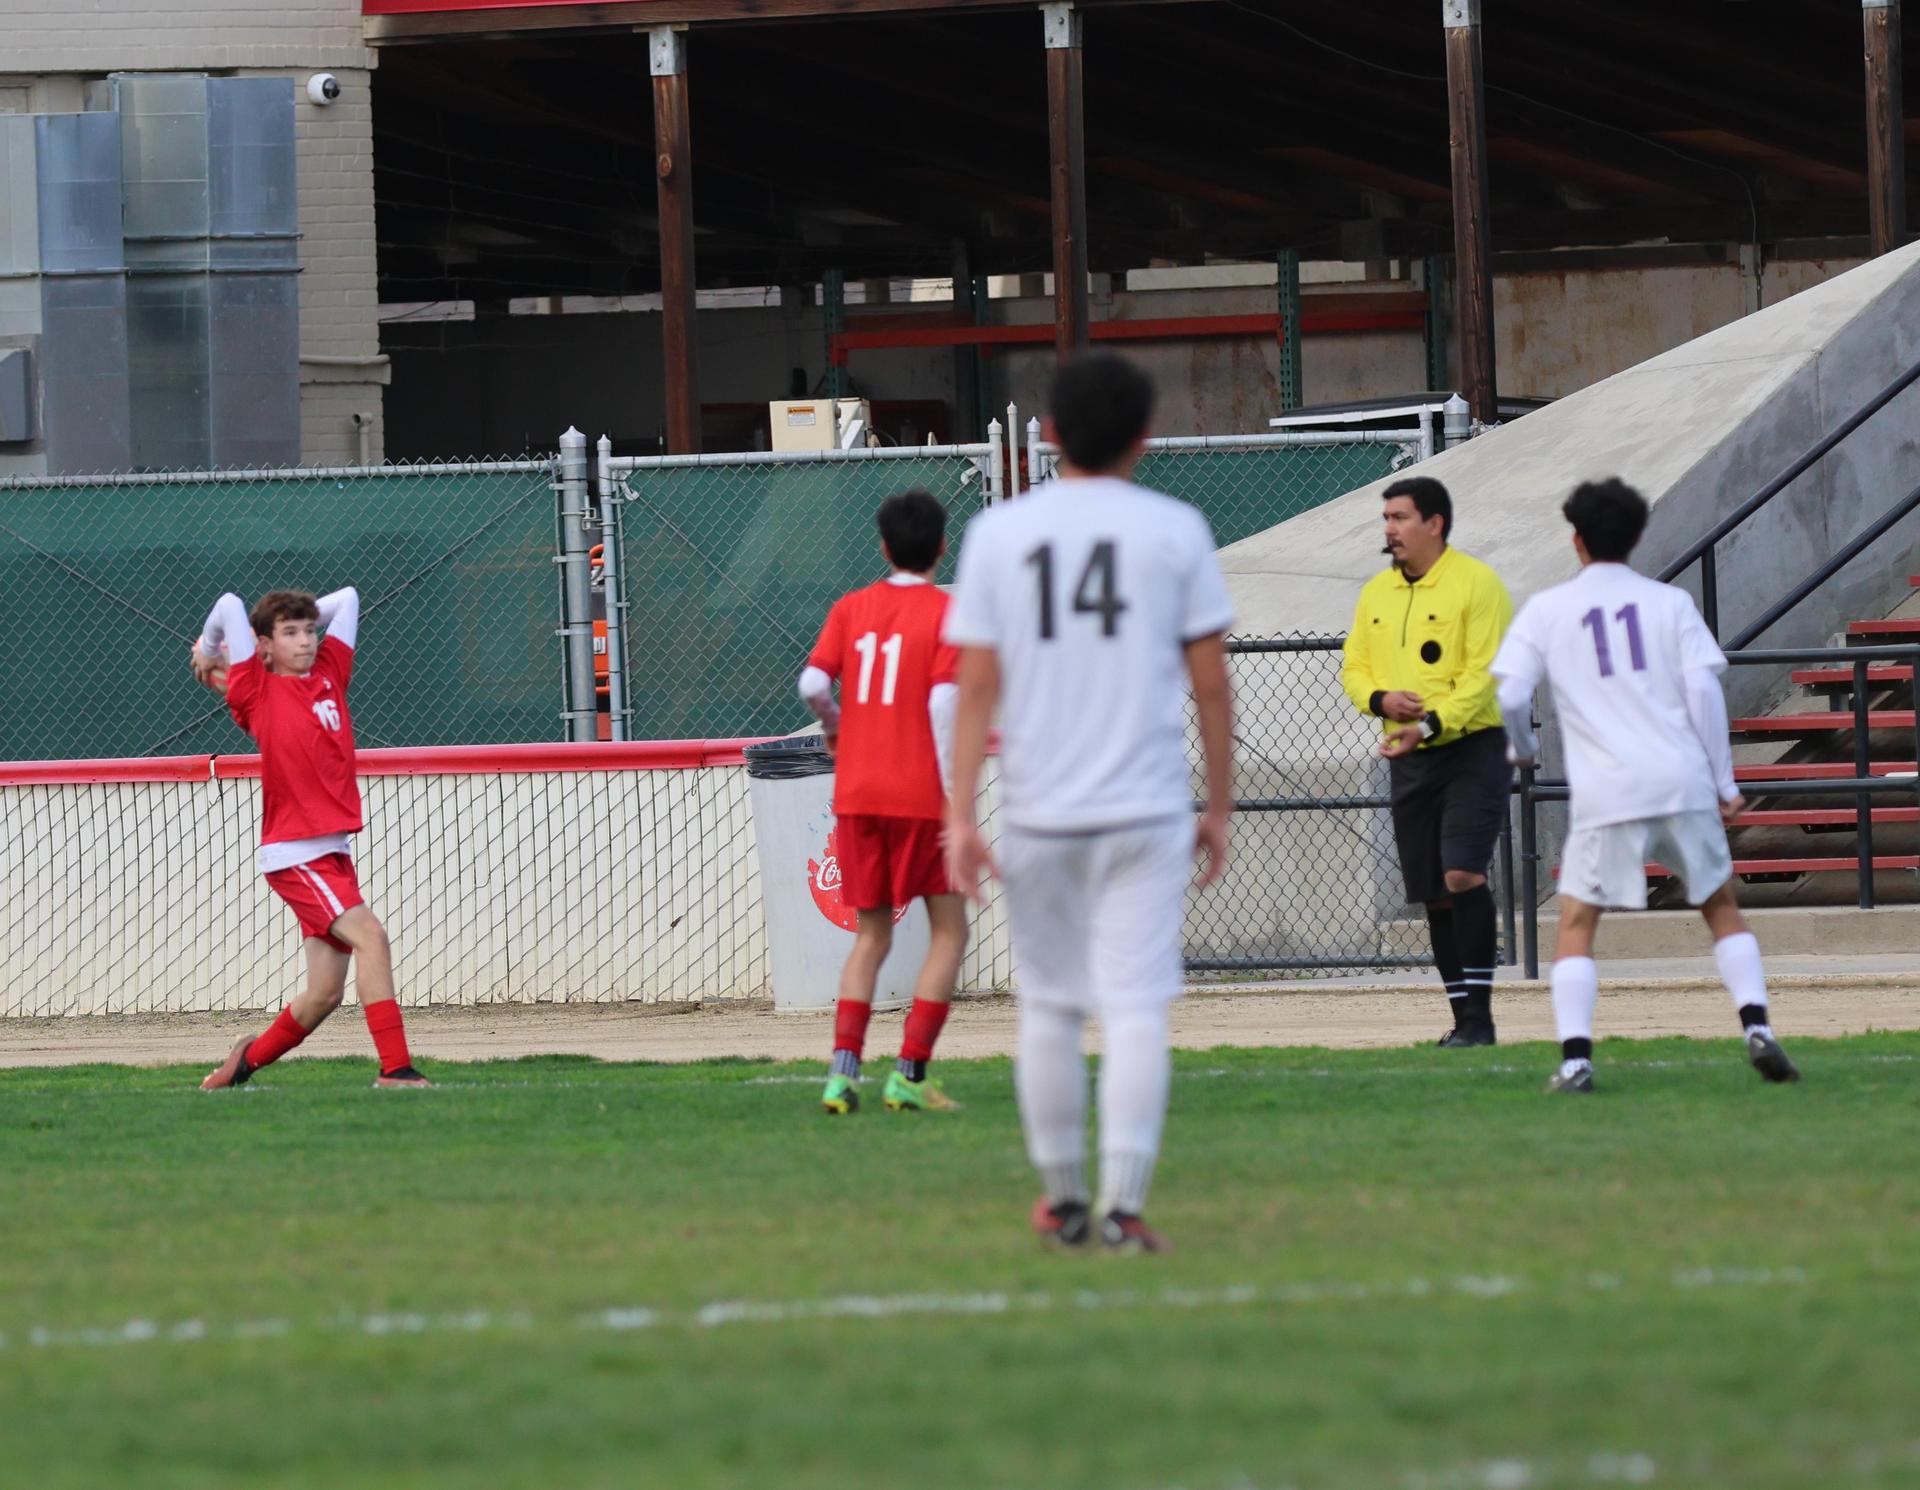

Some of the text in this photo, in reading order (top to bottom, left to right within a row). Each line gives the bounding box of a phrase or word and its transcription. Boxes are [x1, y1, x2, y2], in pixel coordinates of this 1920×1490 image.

[1023, 541, 1128, 639] 14
[854, 631, 903, 705] 11
[1581, 603, 1647, 677] 11
[312, 699, 341, 731] 16
